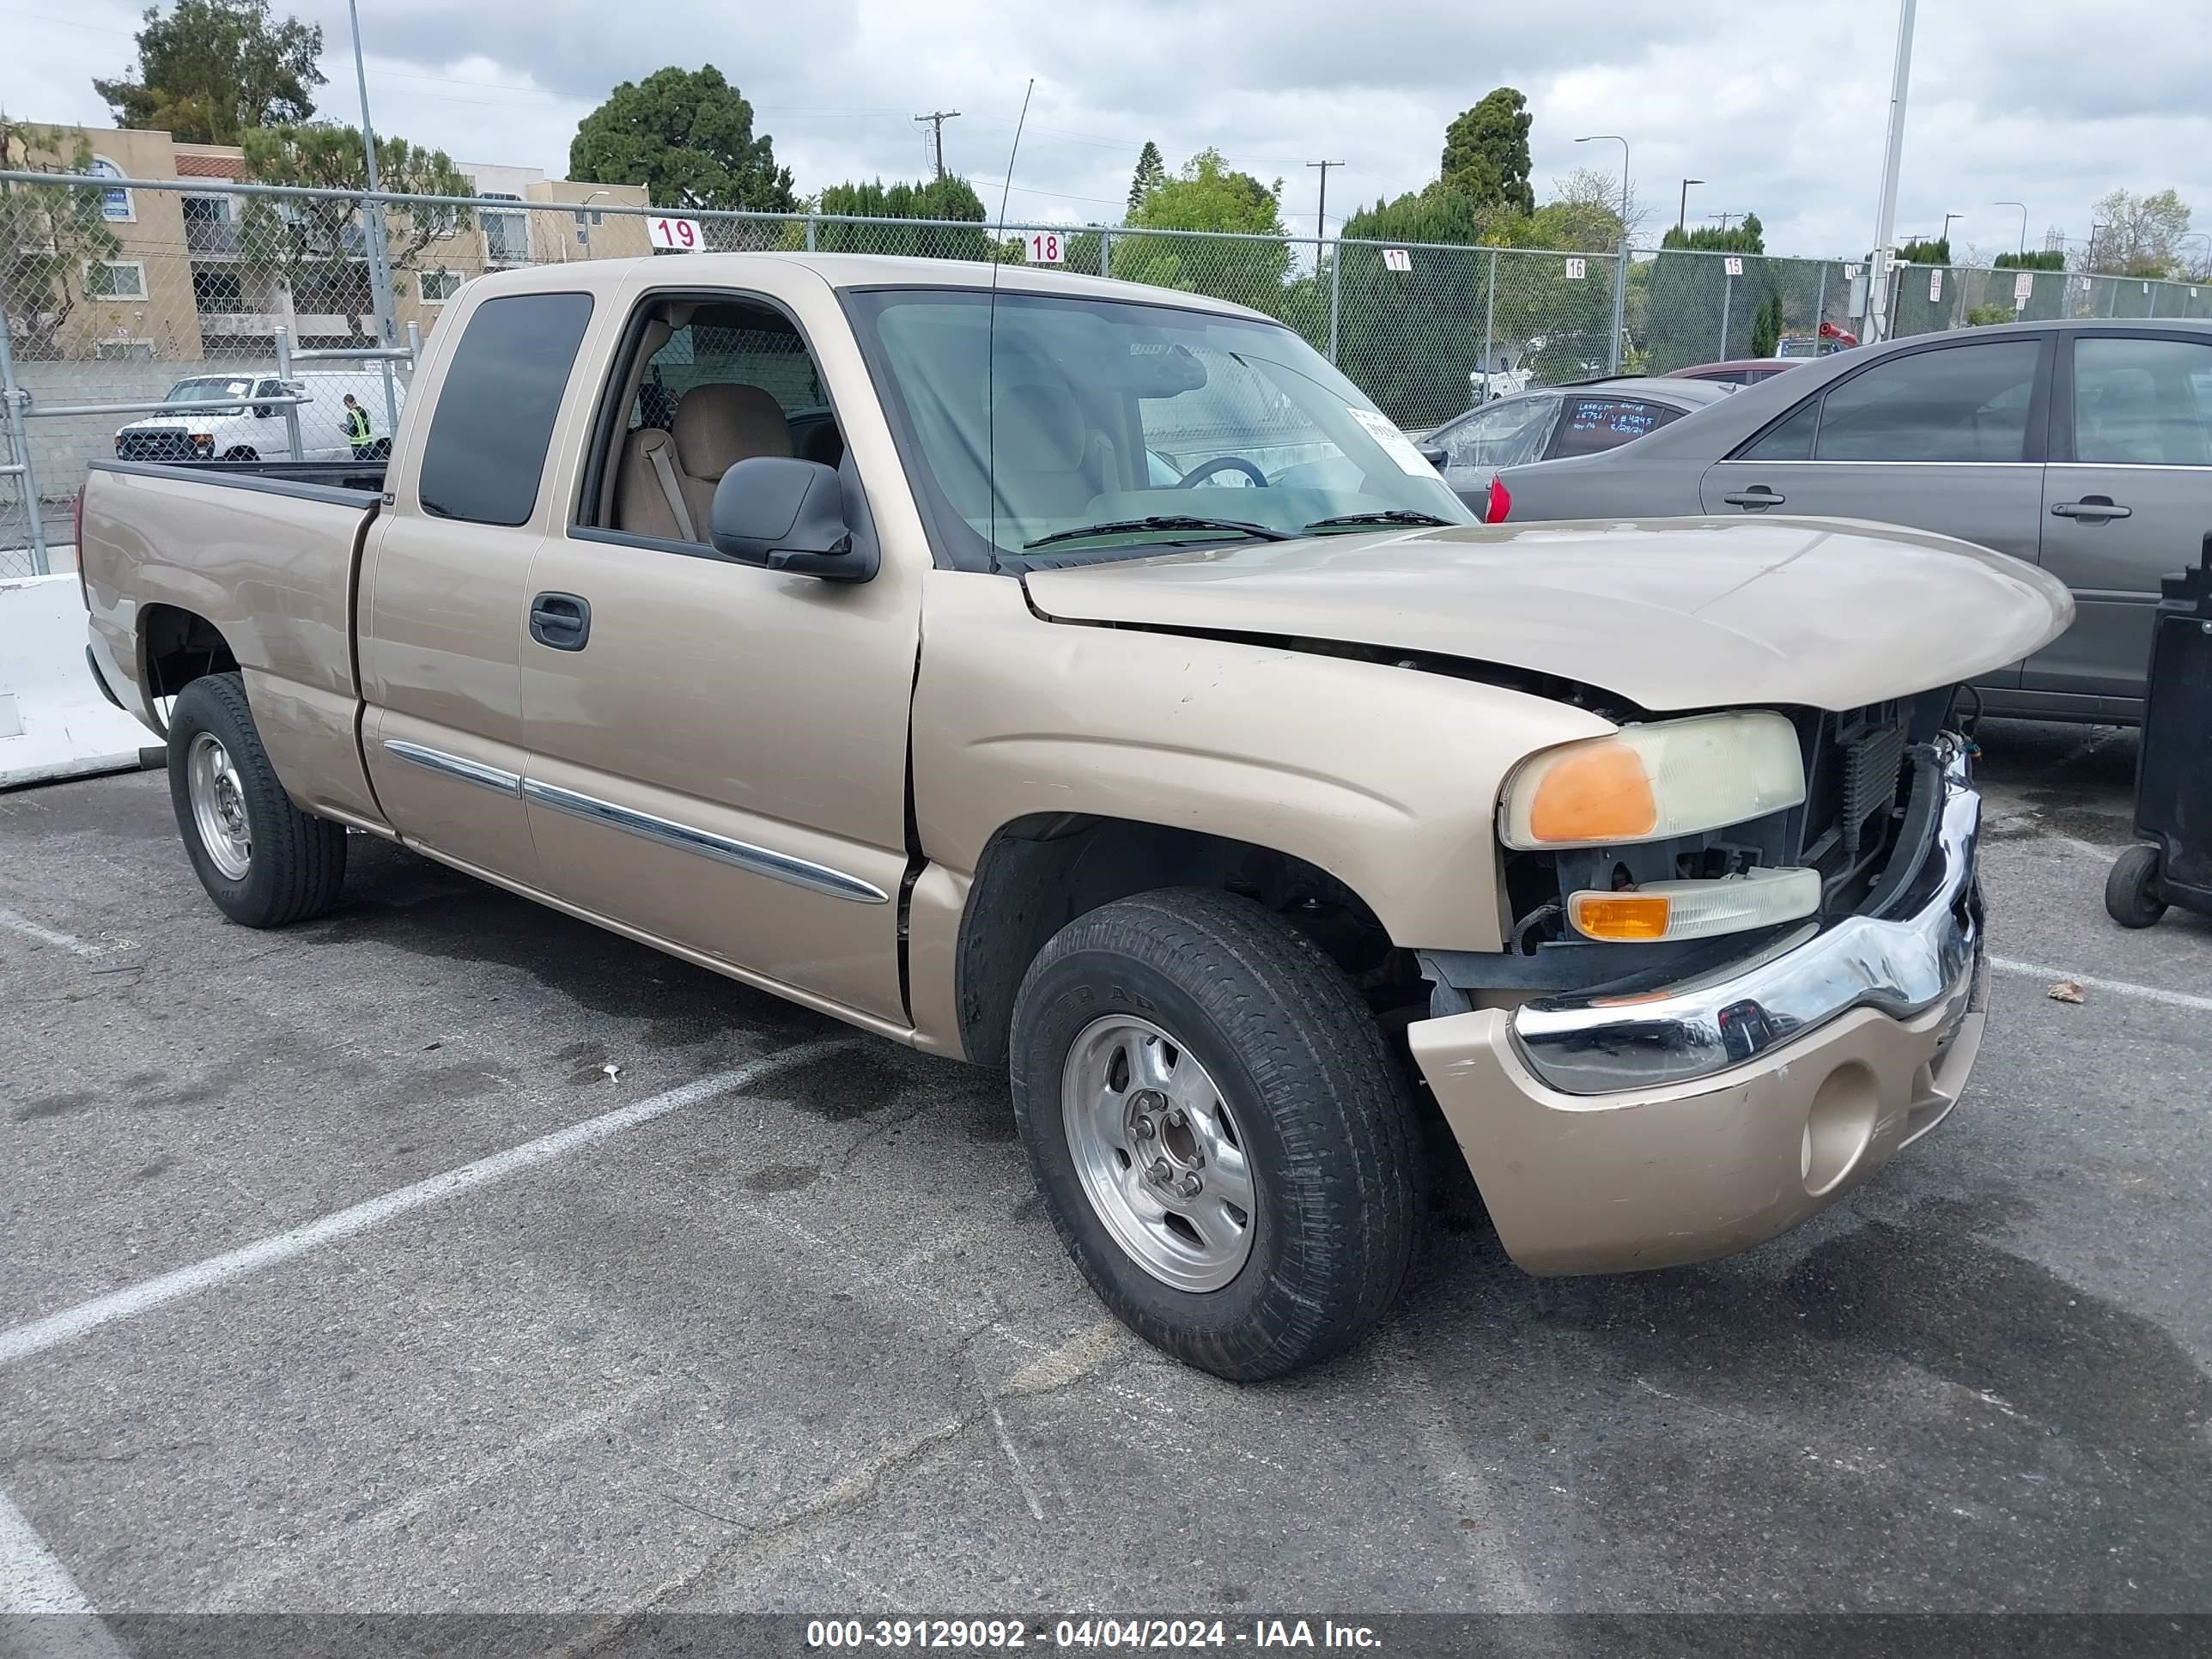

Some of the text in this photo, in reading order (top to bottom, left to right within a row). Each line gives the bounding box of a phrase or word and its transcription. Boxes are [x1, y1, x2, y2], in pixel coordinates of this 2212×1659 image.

[658, 219, 695, 247] 19
[1033, 235, 1058, 260] 18
[1389, 250, 1405, 270] 17
[1570, 259, 1583, 277] 16
[1728, 258, 1740, 274] 15
